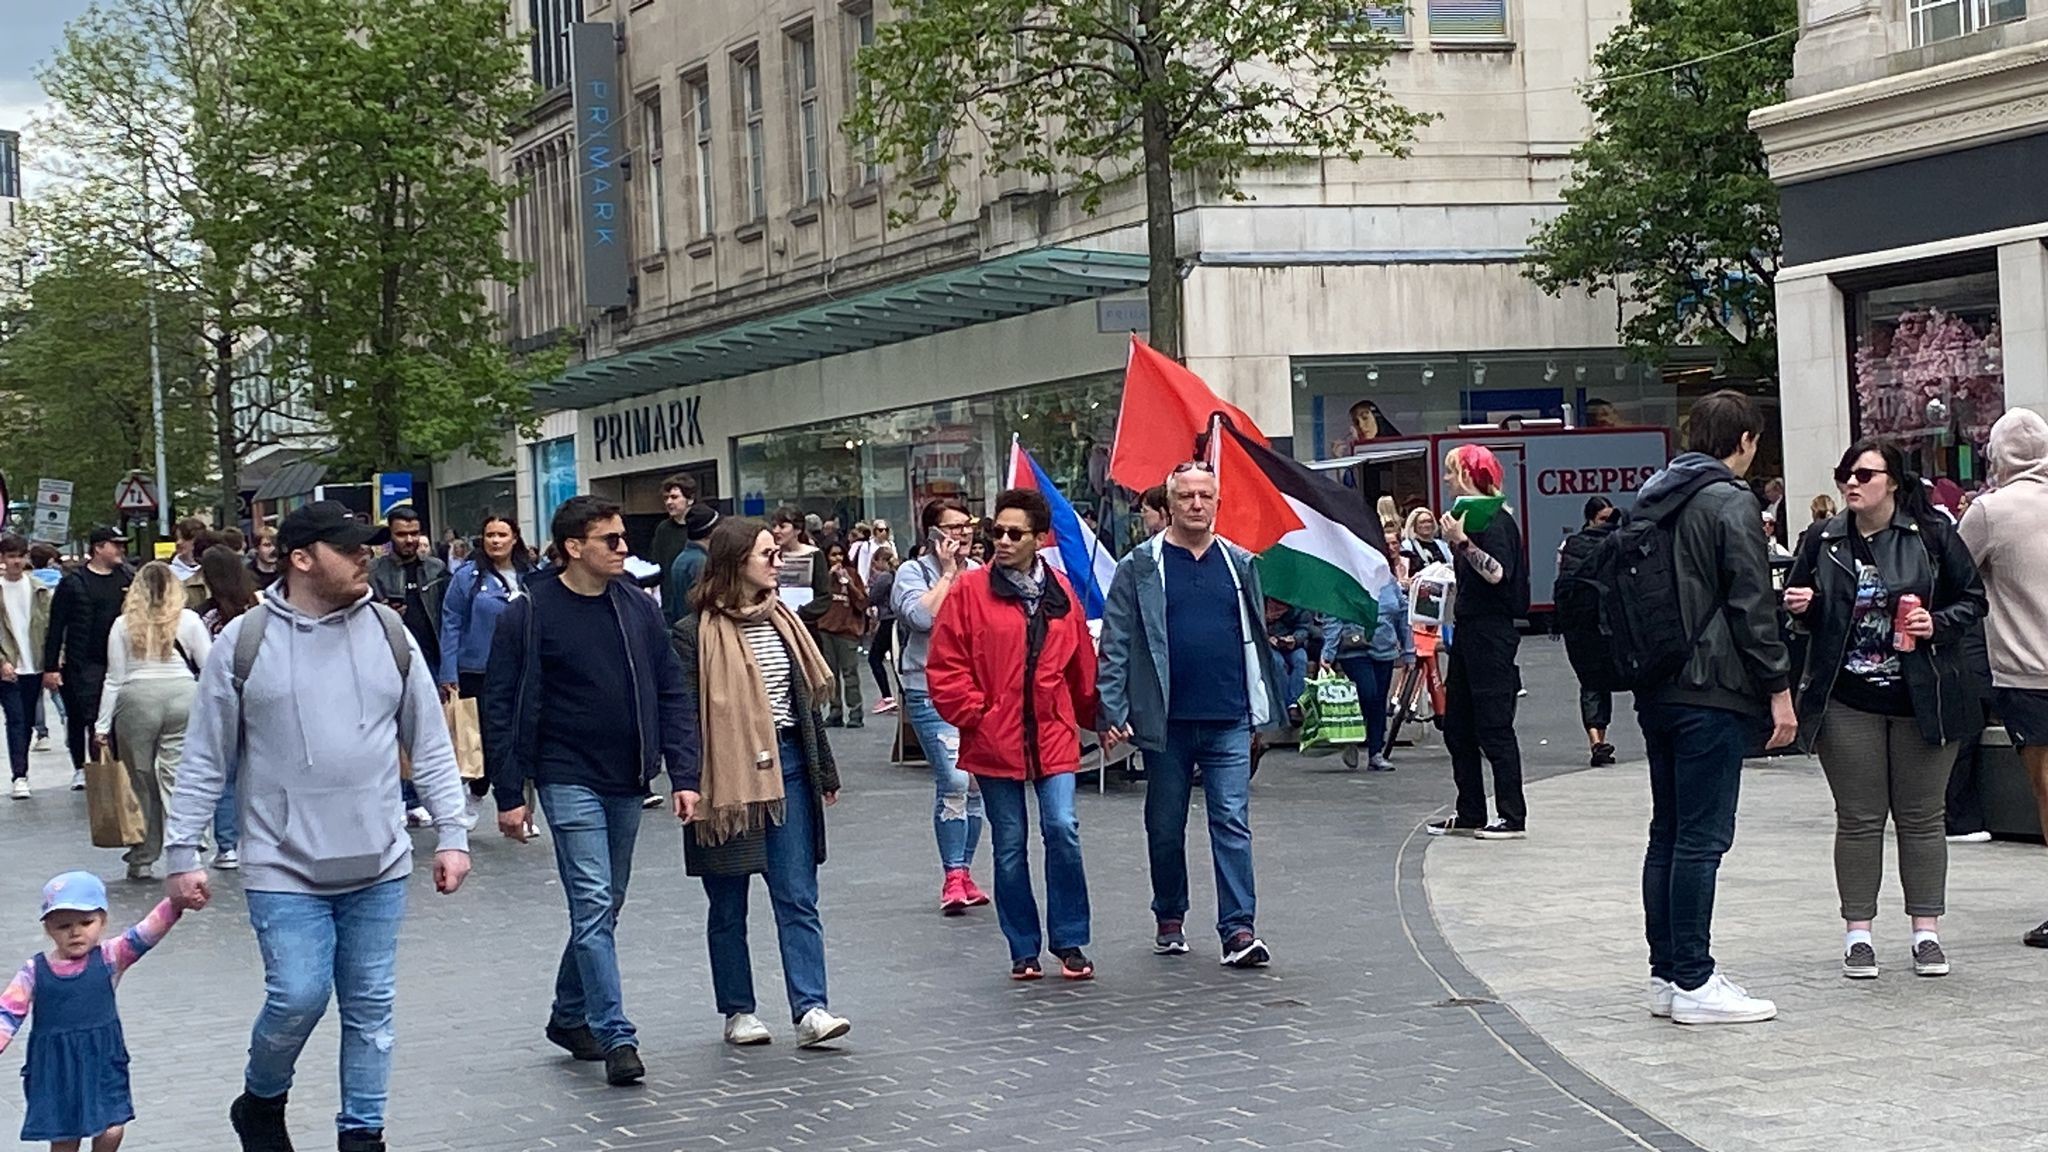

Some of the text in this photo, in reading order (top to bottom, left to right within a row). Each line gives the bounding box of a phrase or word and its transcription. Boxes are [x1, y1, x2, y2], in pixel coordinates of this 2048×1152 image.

[587, 80, 614, 247] PRIMARK
[593, 395, 704, 462] PRIMARK
[1537, 466, 1656, 496] CREPES
